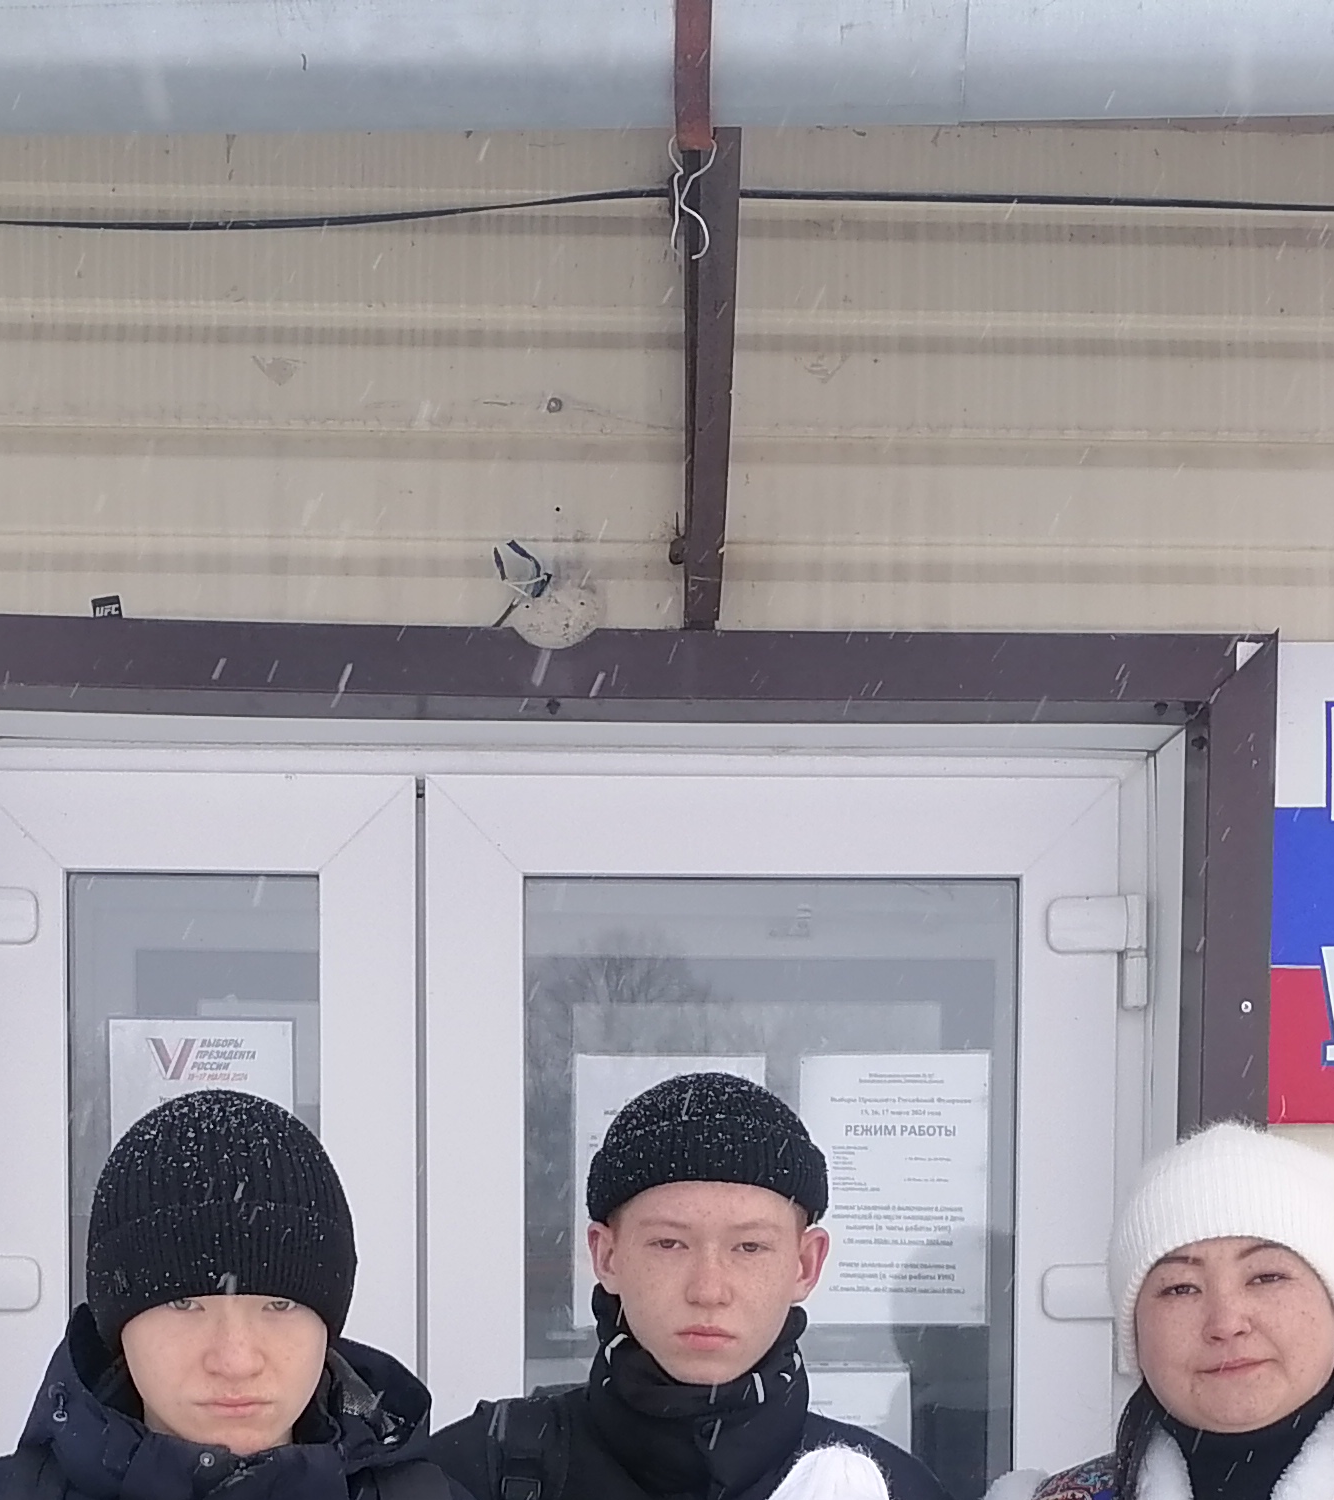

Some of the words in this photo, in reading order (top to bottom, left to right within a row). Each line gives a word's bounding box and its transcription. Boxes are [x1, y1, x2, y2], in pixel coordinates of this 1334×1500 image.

[96, 604, 119, 617] UFC
[200, 1038, 244, 1048] ВЫБОРЫ
[196, 1050, 256, 1060] ПРЕЗИДЕНТА
[191, 1062, 230, 1070] РОССИИ
[844, 1124, 896, 1136] РЕЖИМ
[900, 1124, 956, 1137] РАБОТЫ
